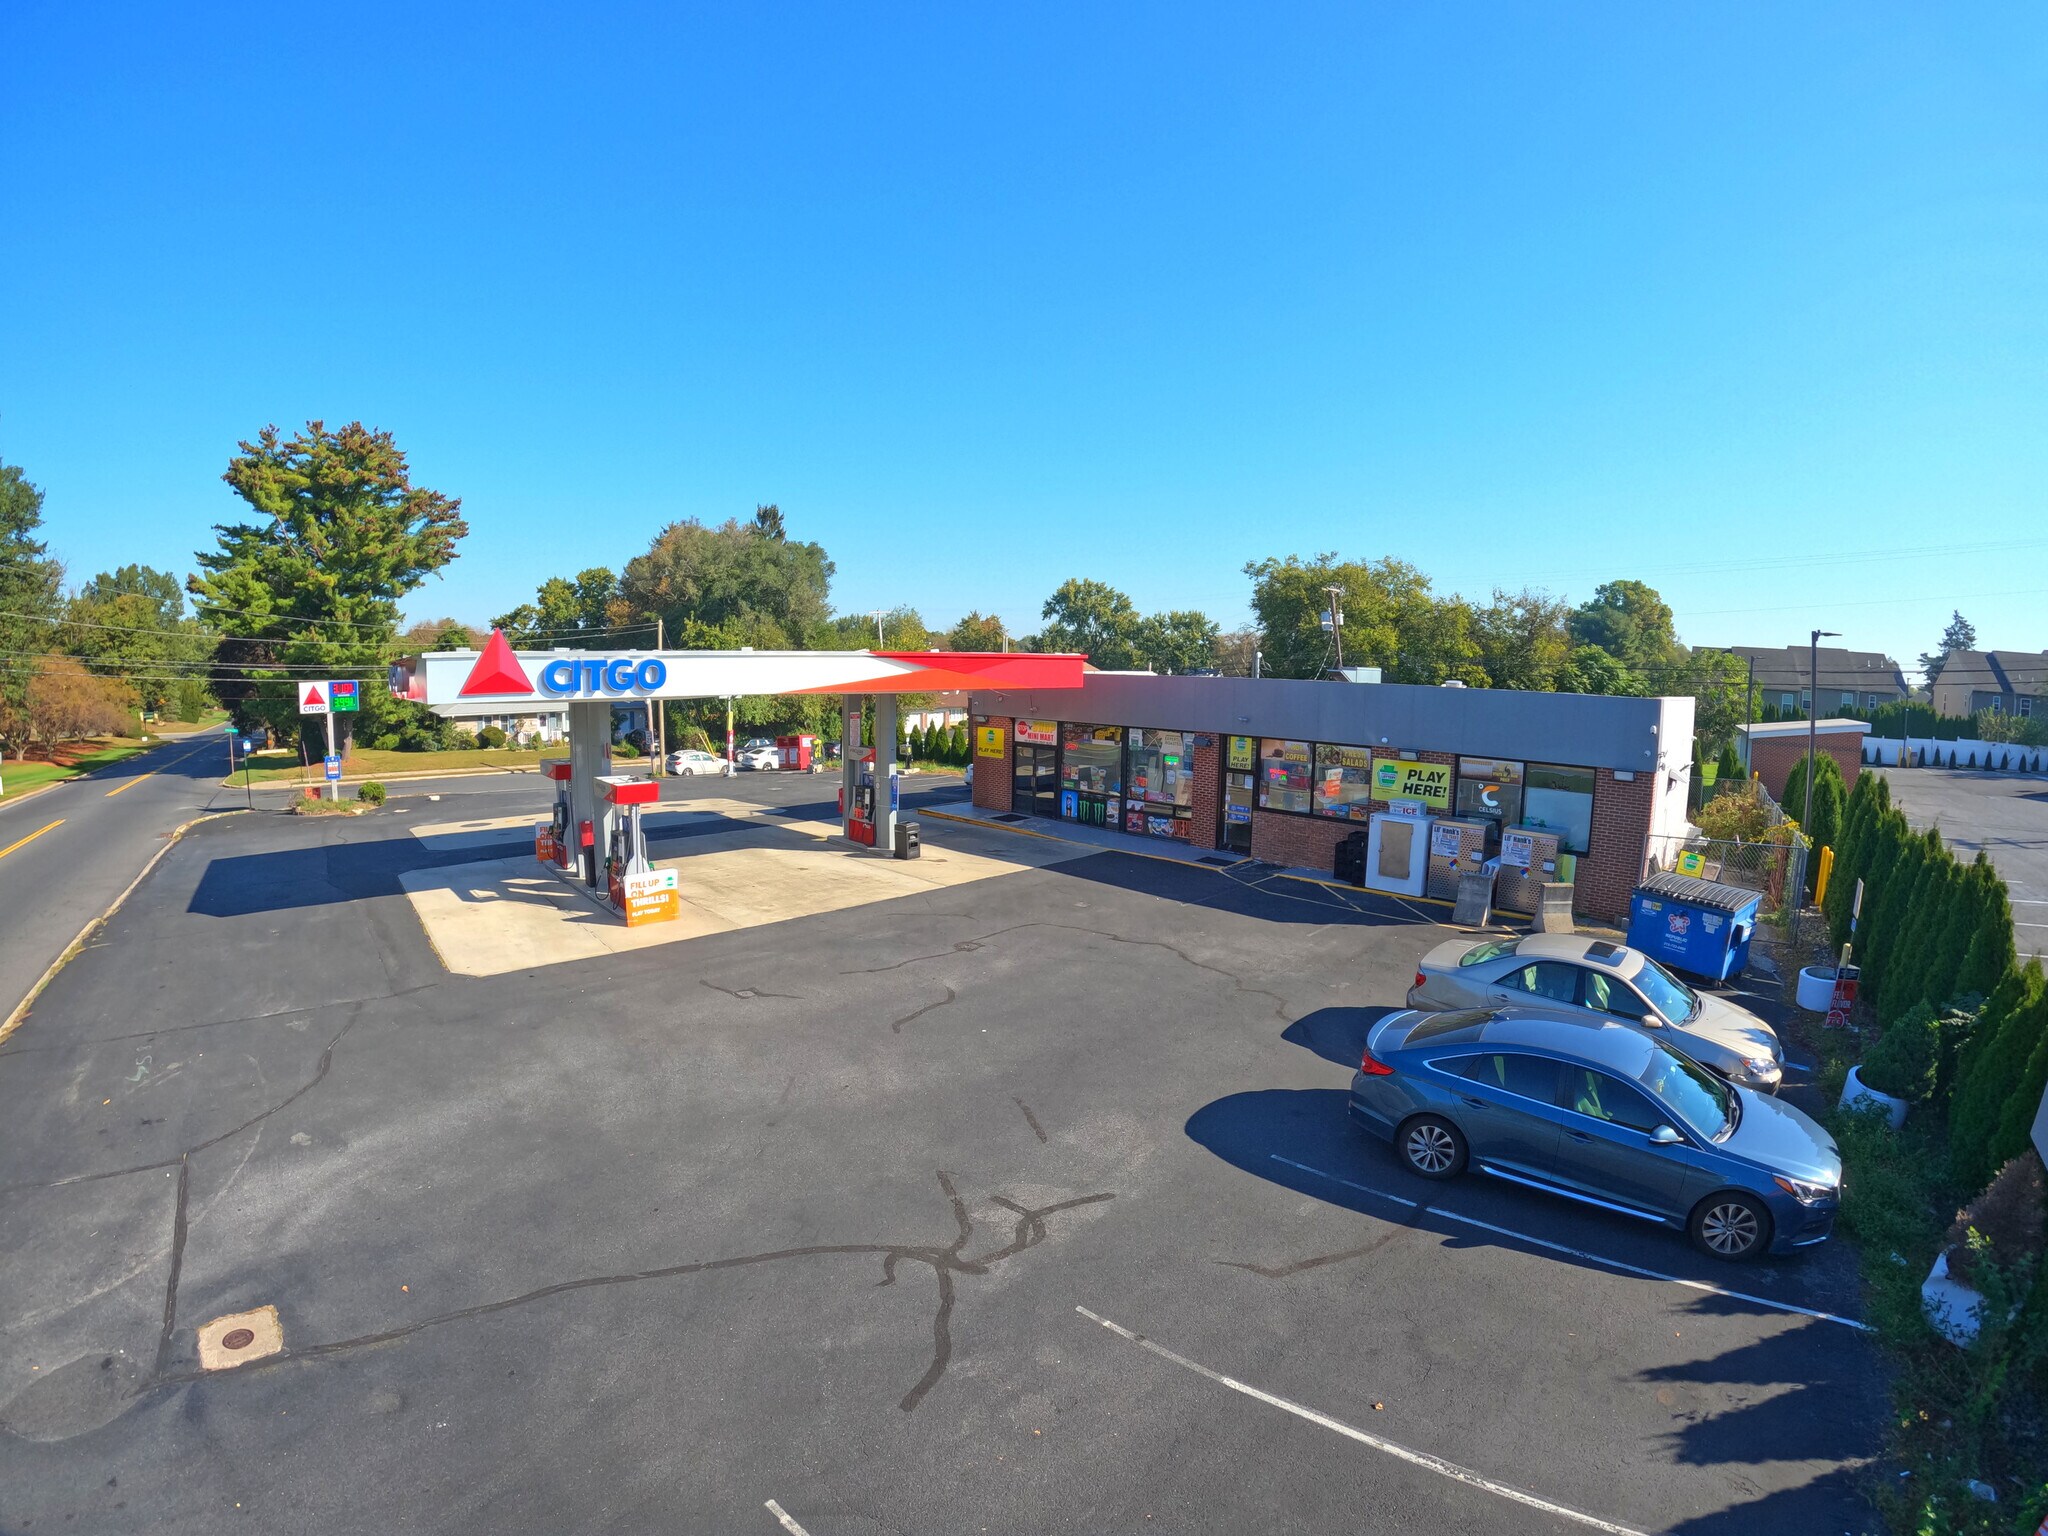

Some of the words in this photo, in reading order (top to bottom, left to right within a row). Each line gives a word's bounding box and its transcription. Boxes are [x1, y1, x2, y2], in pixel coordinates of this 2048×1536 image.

[543, 658, 667, 692] CITGO
[1032, 720, 1057, 734] SHOP
[1027, 732, 1039, 740] MINI
[1039, 732, 1054, 742] MART
[1291, 743, 1304, 751] HOT
[1285, 753, 1308, 762] COFFEE
[1344, 750, 1366, 759] FRESH
[1341, 758, 1368, 768] SALADS
[1407, 769, 1446, 784] PLAY
[1402, 782, 1447, 798] HERE!
[1402, 807, 1418, 816] ICE
[1478, 806, 1502, 815] CELSIUS
[630, 881, 647, 889] FILL
[648, 879, 660, 887] UP
[630, 890, 645, 898] ON
[630, 894, 669, 908] THRILLS!
[1665, 933, 1688, 943] REPUBLIC
